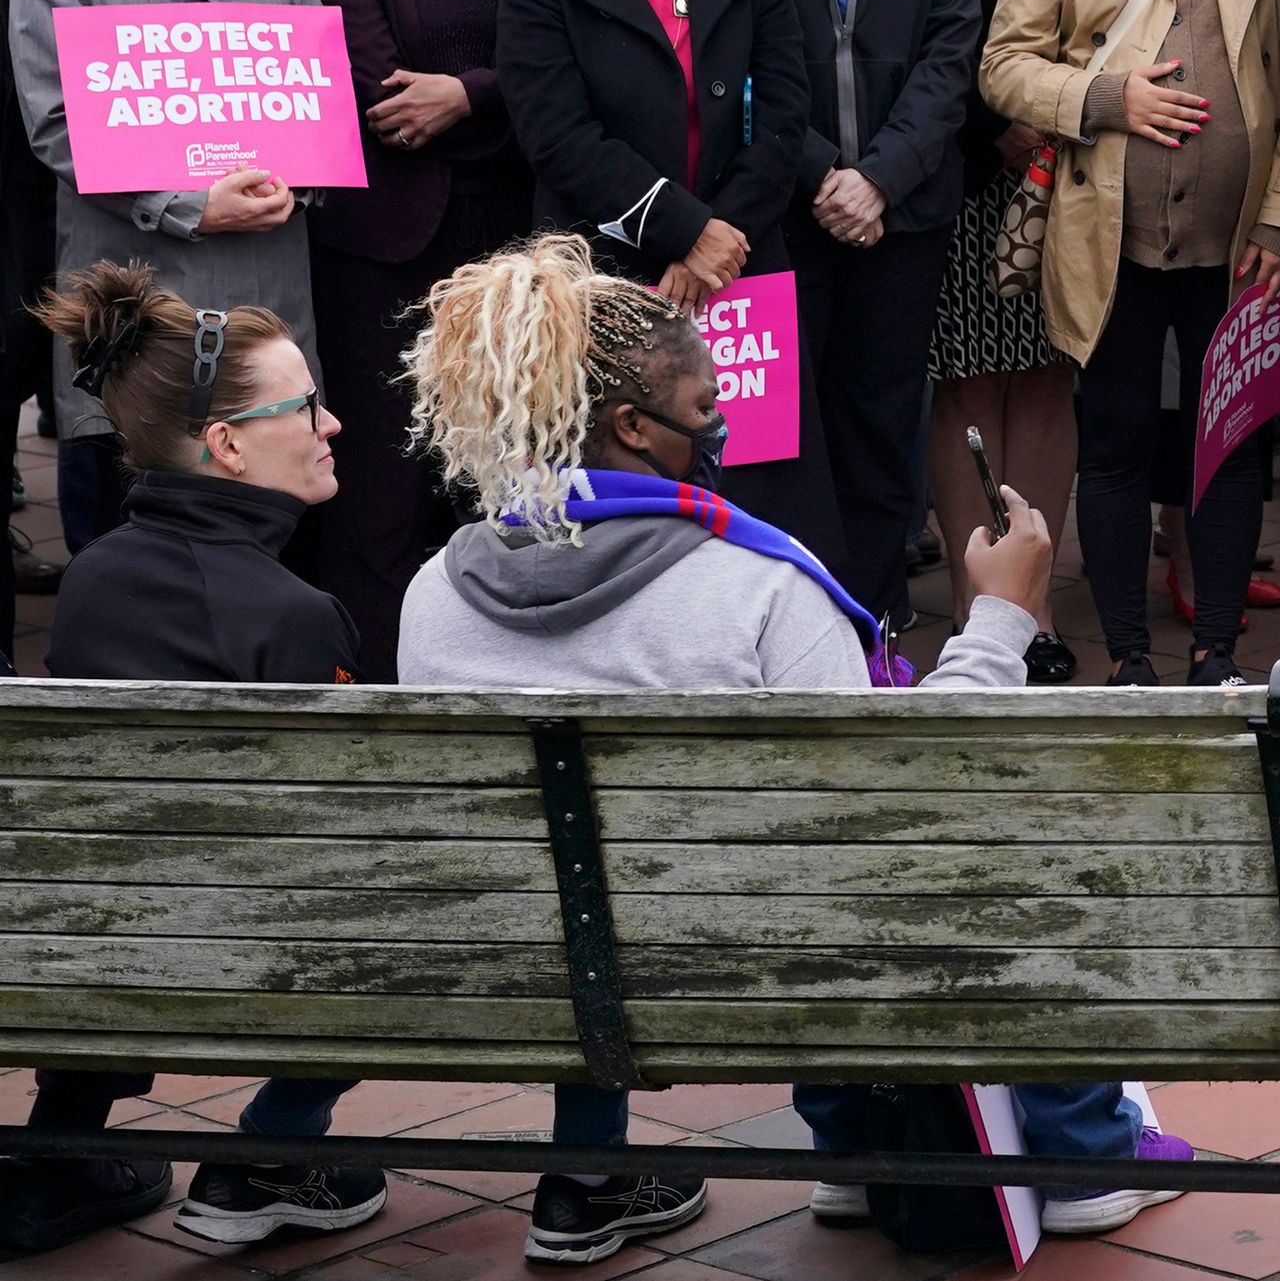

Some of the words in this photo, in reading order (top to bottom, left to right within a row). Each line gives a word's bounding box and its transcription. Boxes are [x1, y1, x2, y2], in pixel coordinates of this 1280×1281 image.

[115, 22, 294, 55] PROTECT
[85, 58, 202, 93] SAFE,
[212, 56, 332, 88] LEGAL
[106, 91, 322, 128] ABORTION
[204, 141, 240, 152] Planned
[205, 150, 257, 161] Parenthood
[708, 331, 780, 368] GAL
[1203, 351, 1236, 418] SAFE,
